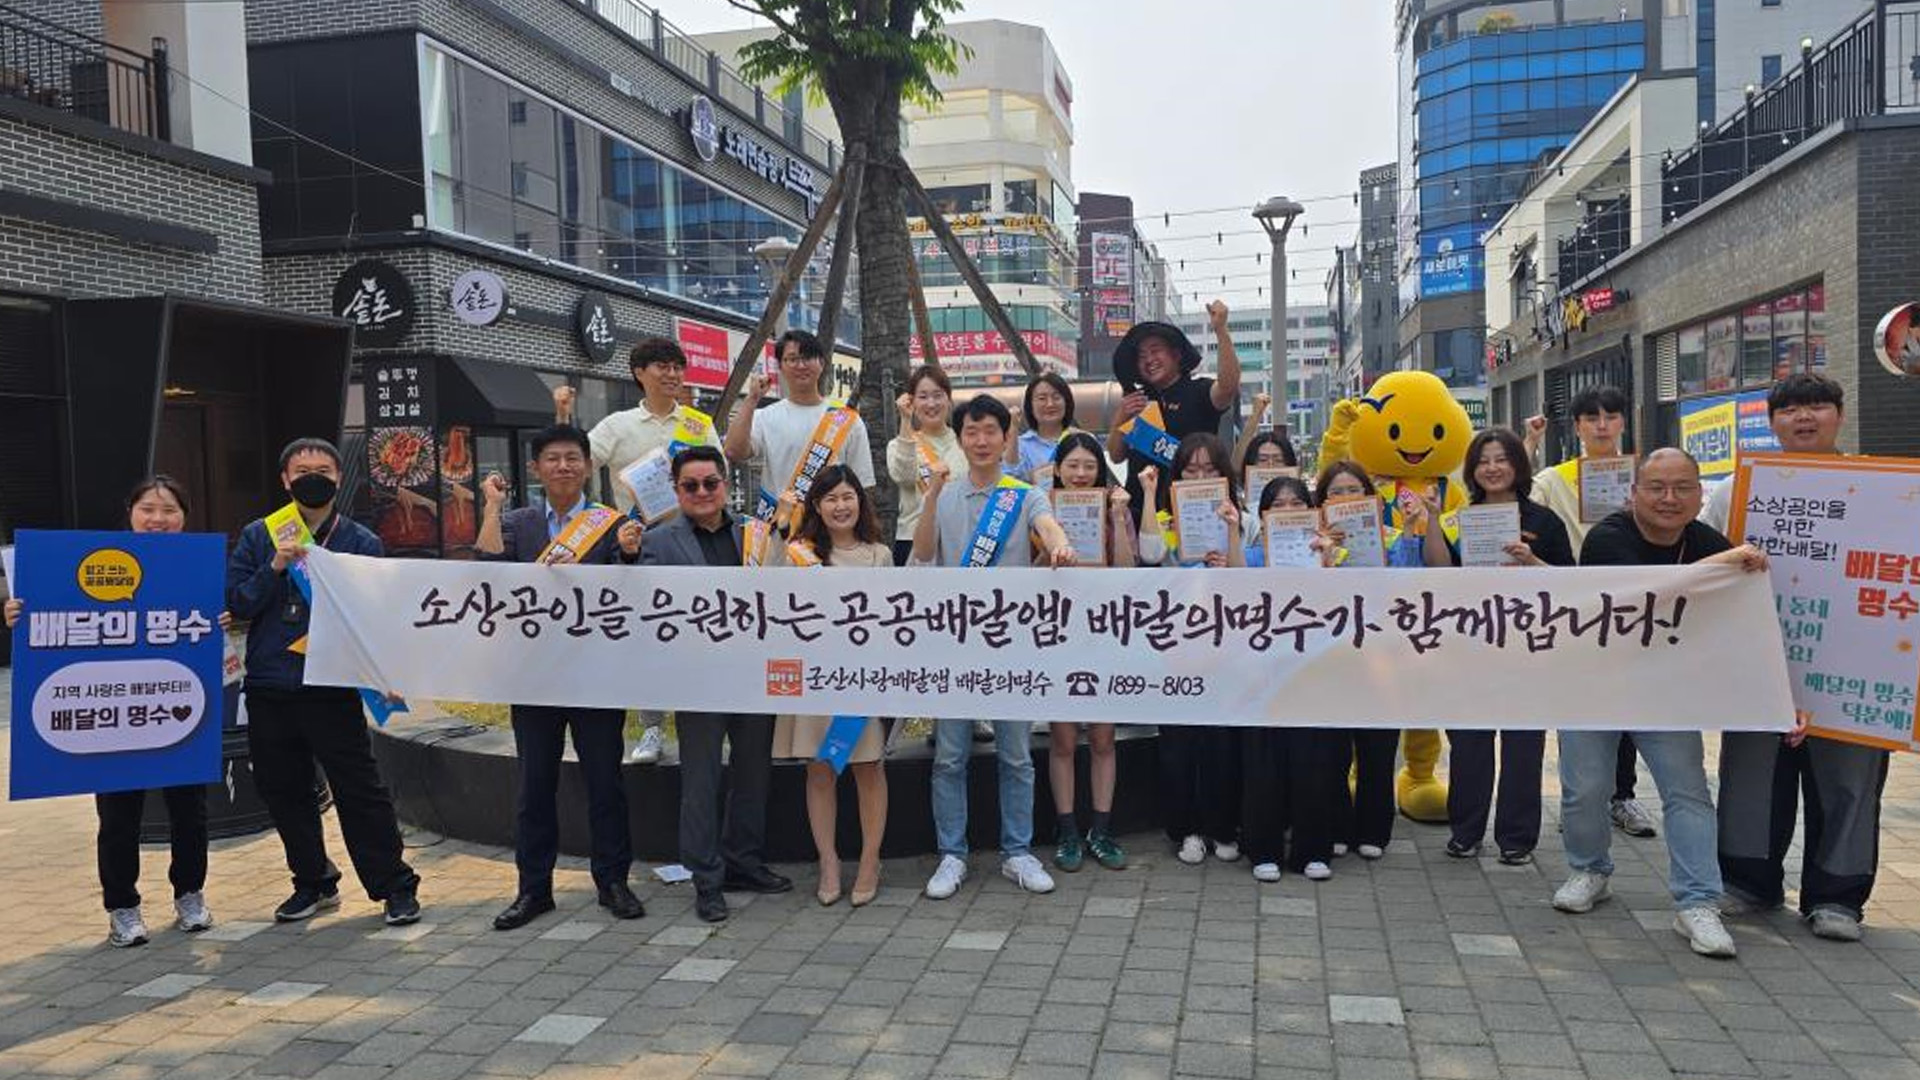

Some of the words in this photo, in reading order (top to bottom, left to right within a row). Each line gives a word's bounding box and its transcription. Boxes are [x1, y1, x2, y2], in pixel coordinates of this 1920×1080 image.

[1744, 496, 1847, 520] 소상공인을
[1773, 519, 1815, 538] 위한
[413, 582, 633, 640] 소상공인을
[641, 588, 825, 642] 응원하는
[832, 589, 1072, 649] 공공배달앱!
[1087, 589, 1383, 653] 배달의명수가
[1389, 591, 1687, 654] 함께합니다!
[1790, 596, 1829, 619] 동네
[1858, 587, 1919, 620] 명수
[29, 610, 137, 648] 배달의
[146, 609, 212, 645] 명수
[53, 685, 81, 699] 지역
[86, 683, 127, 698] 사랑은
[806, 666, 950, 693] 군산사랑배달앱
[955, 666, 1054, 696] 배달의명수
[1108, 675, 1205, 696] 1899-8103
[1804, 672, 1867, 699] 배달의
[1873, 682, 1914, 706] 명수
[51, 706, 119, 731] 배달의
[128, 704, 171, 727] 명수
[1842, 701, 1912, 731] 덕분에!
